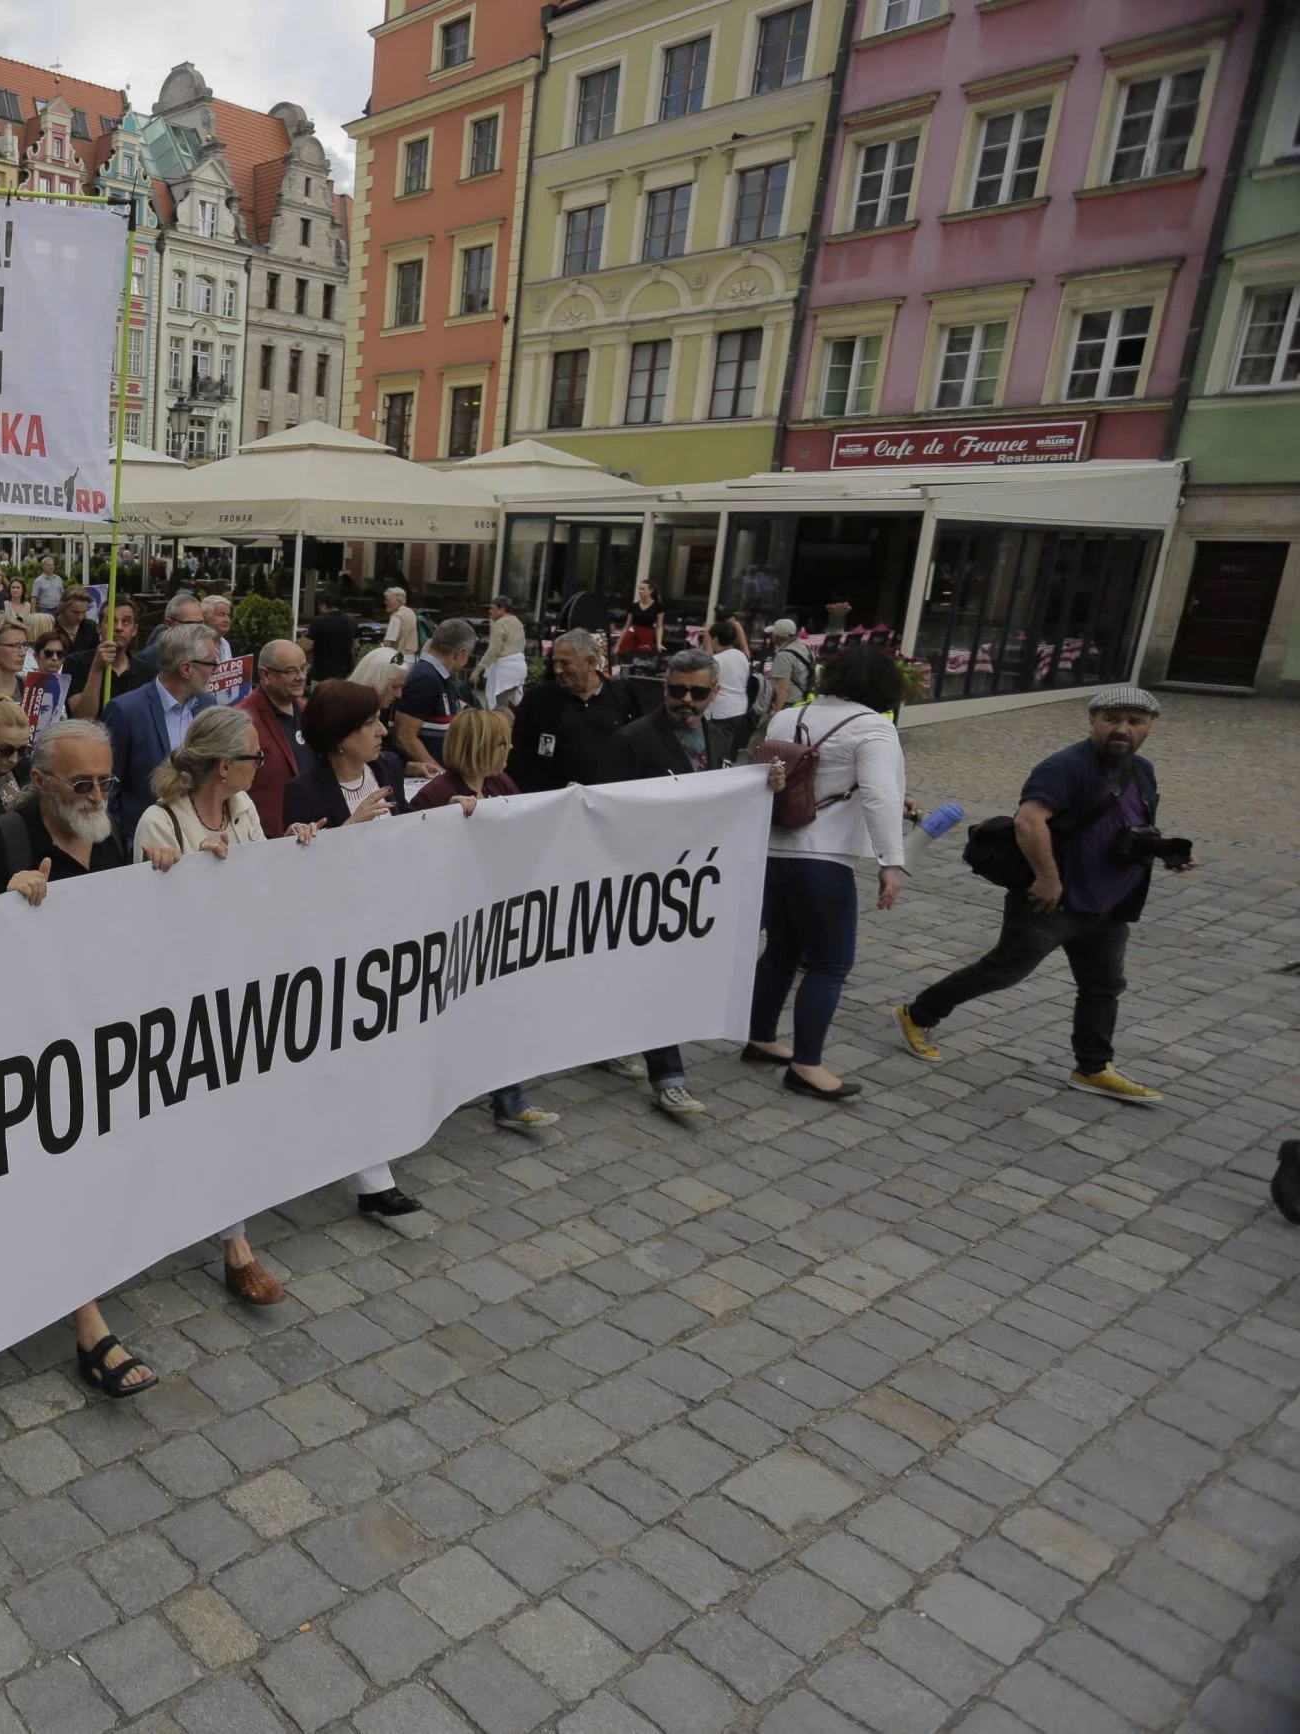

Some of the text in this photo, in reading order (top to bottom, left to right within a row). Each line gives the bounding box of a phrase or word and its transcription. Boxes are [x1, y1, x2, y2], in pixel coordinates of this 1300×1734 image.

[873, 435, 1029, 459] Cafe de France
[997, 452, 1075, 464] Restaurant
[75, 488, 106, 514] RP
[341, 515, 404, 526] RESTAURACJA
[230, 660, 243, 670] PO
[225, 677, 243, 687] 17.00
[95, 966, 323, 1136] PRAWO
[330, 957, 346, 1052] I
[353, 846, 721, 1042] SPRAWIEDLIWOŚĆ
